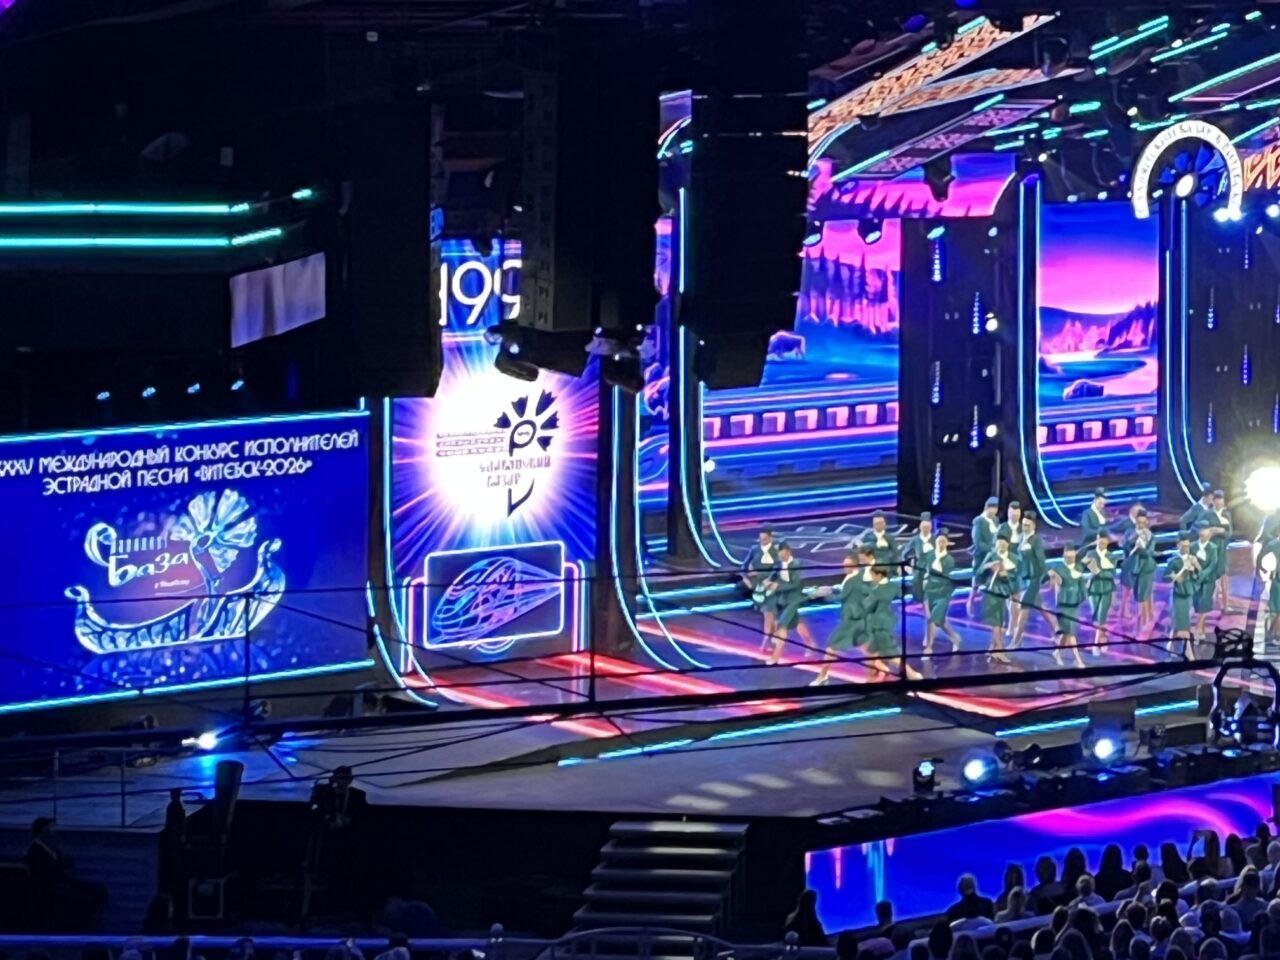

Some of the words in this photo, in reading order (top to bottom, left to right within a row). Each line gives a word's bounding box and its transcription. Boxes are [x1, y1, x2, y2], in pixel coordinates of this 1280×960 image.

[38, 445, 170, 474] МЕЖДУНАРОДНЫЙ
[174, 441, 240, 463] КОНКУРС
[243, 429, 359, 457] ИСПОЛНИТЕЛЕЙ
[42, 470, 132, 496] ЭСТРАДНОЙ
[136, 466, 189, 487] ПЕСНИ
